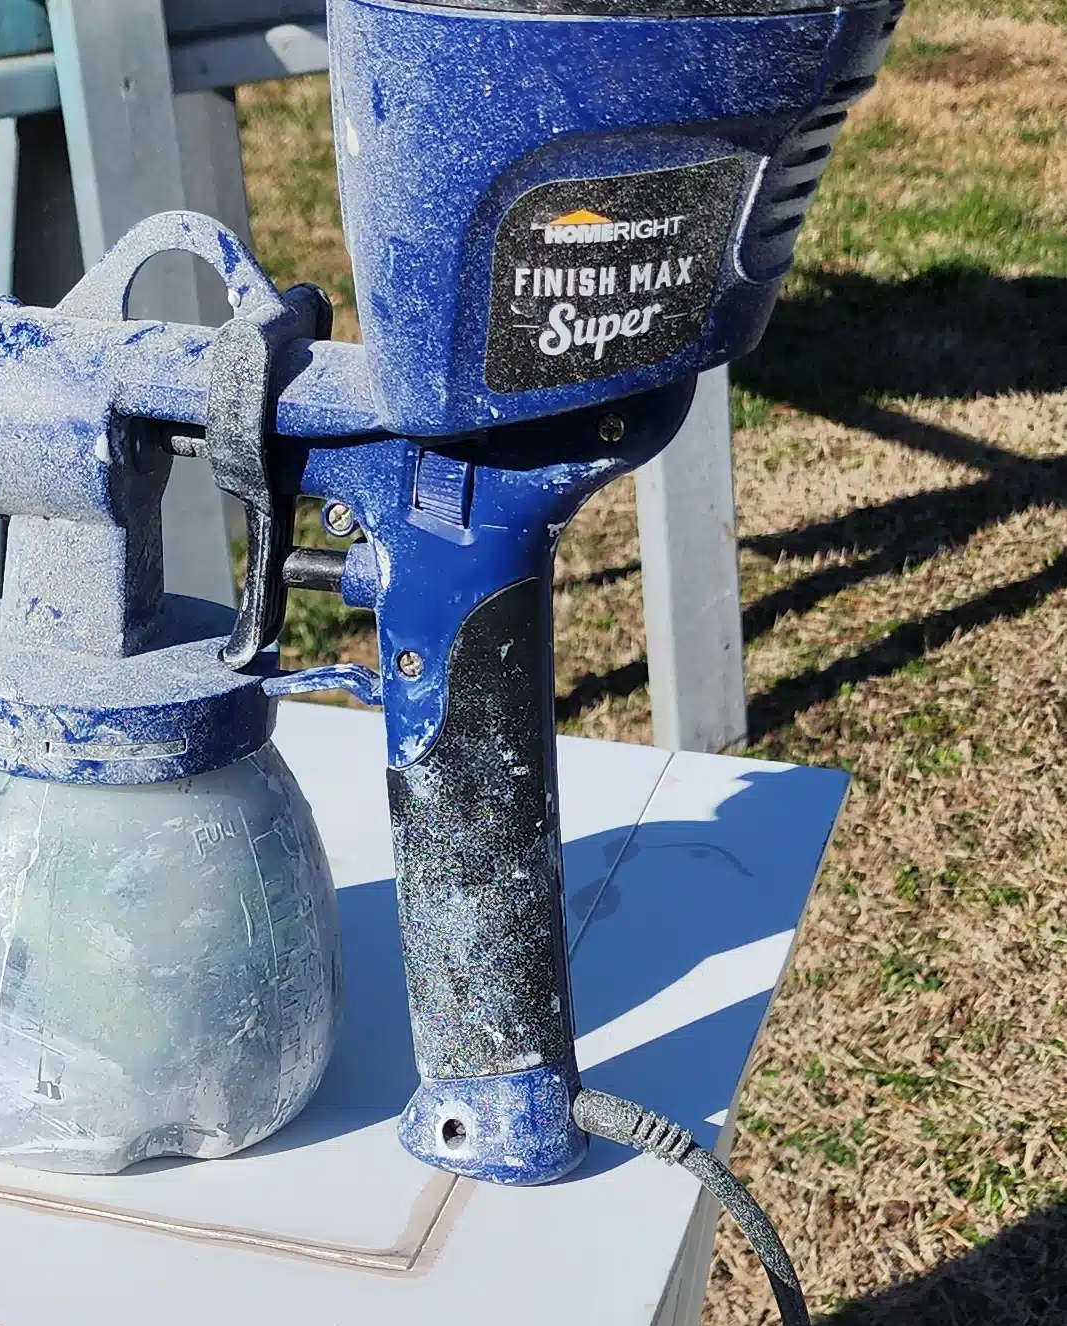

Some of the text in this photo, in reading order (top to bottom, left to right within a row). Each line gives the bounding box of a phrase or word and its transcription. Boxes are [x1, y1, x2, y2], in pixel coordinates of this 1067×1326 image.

[514, 256, 693, 297] FINISH MAX
[538, 302, 663, 361] Super
